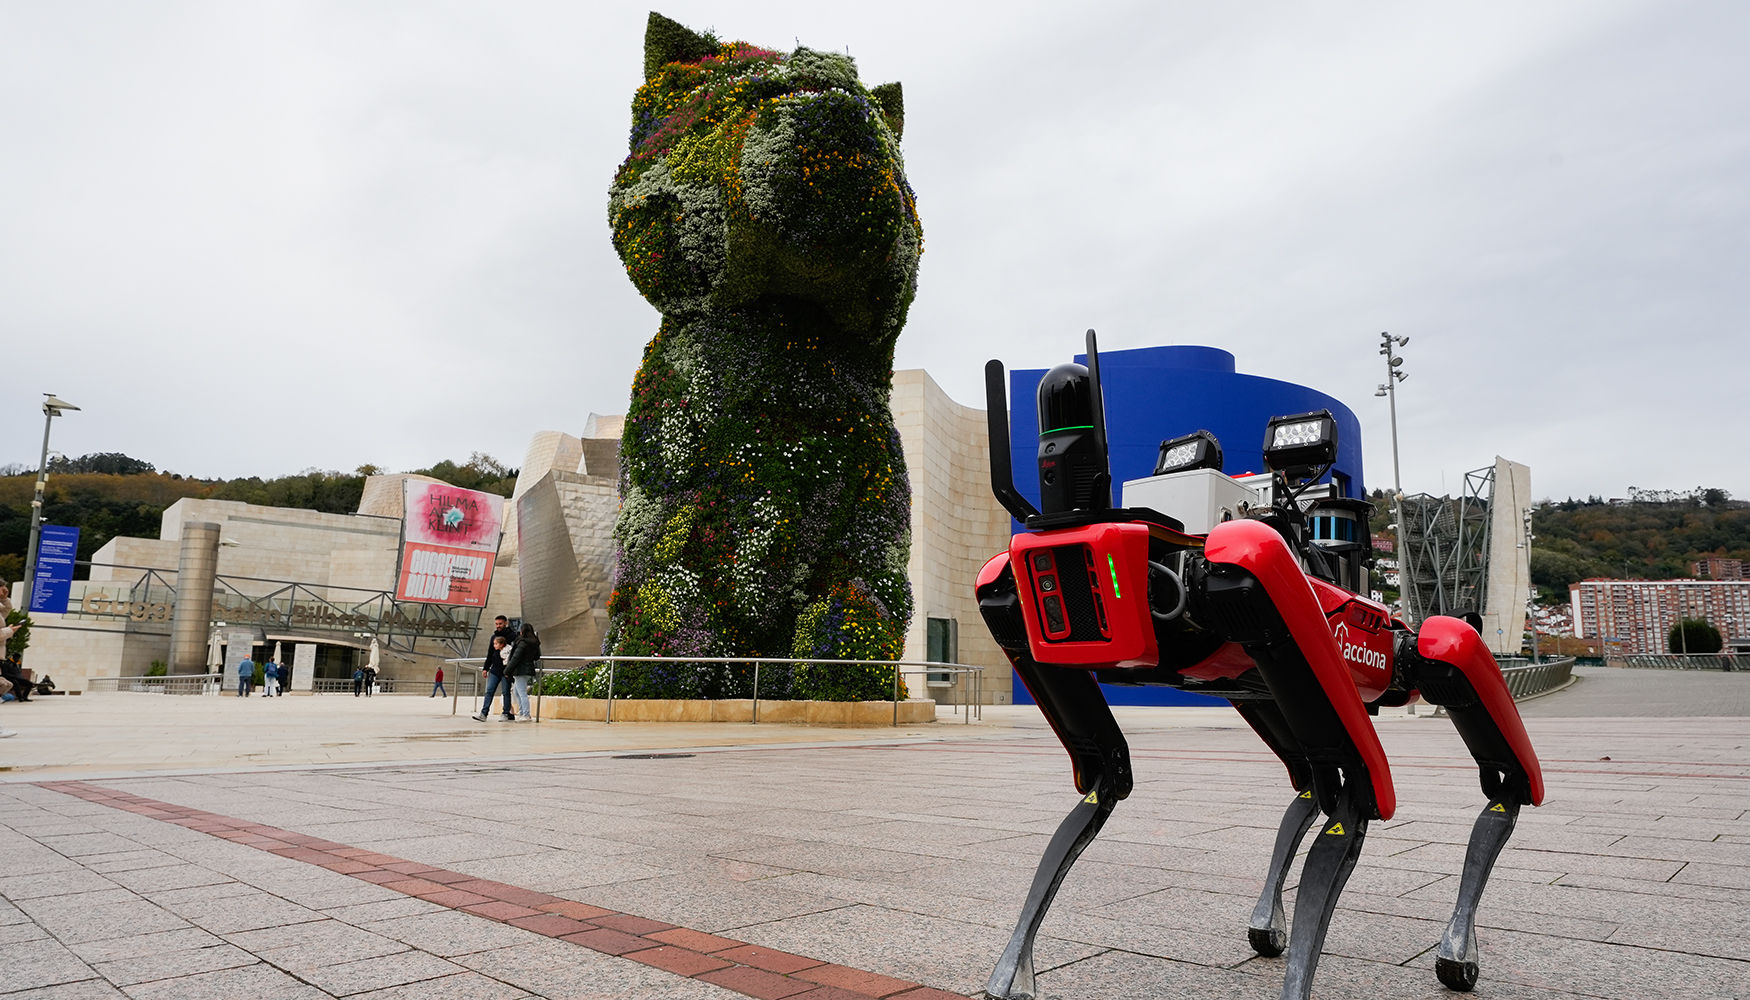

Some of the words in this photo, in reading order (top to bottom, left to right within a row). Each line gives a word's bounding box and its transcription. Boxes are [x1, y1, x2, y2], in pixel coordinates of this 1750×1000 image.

[429, 507, 448, 518] AF
[430, 494, 478, 511] HILMA
[428, 519, 472, 534] KLINT
[404, 573, 452, 600] BILBAO
[292, 604, 369, 626] Bilbao
[381, 611, 469, 632] Museoa
[1344, 642, 1386, 670] acciona
